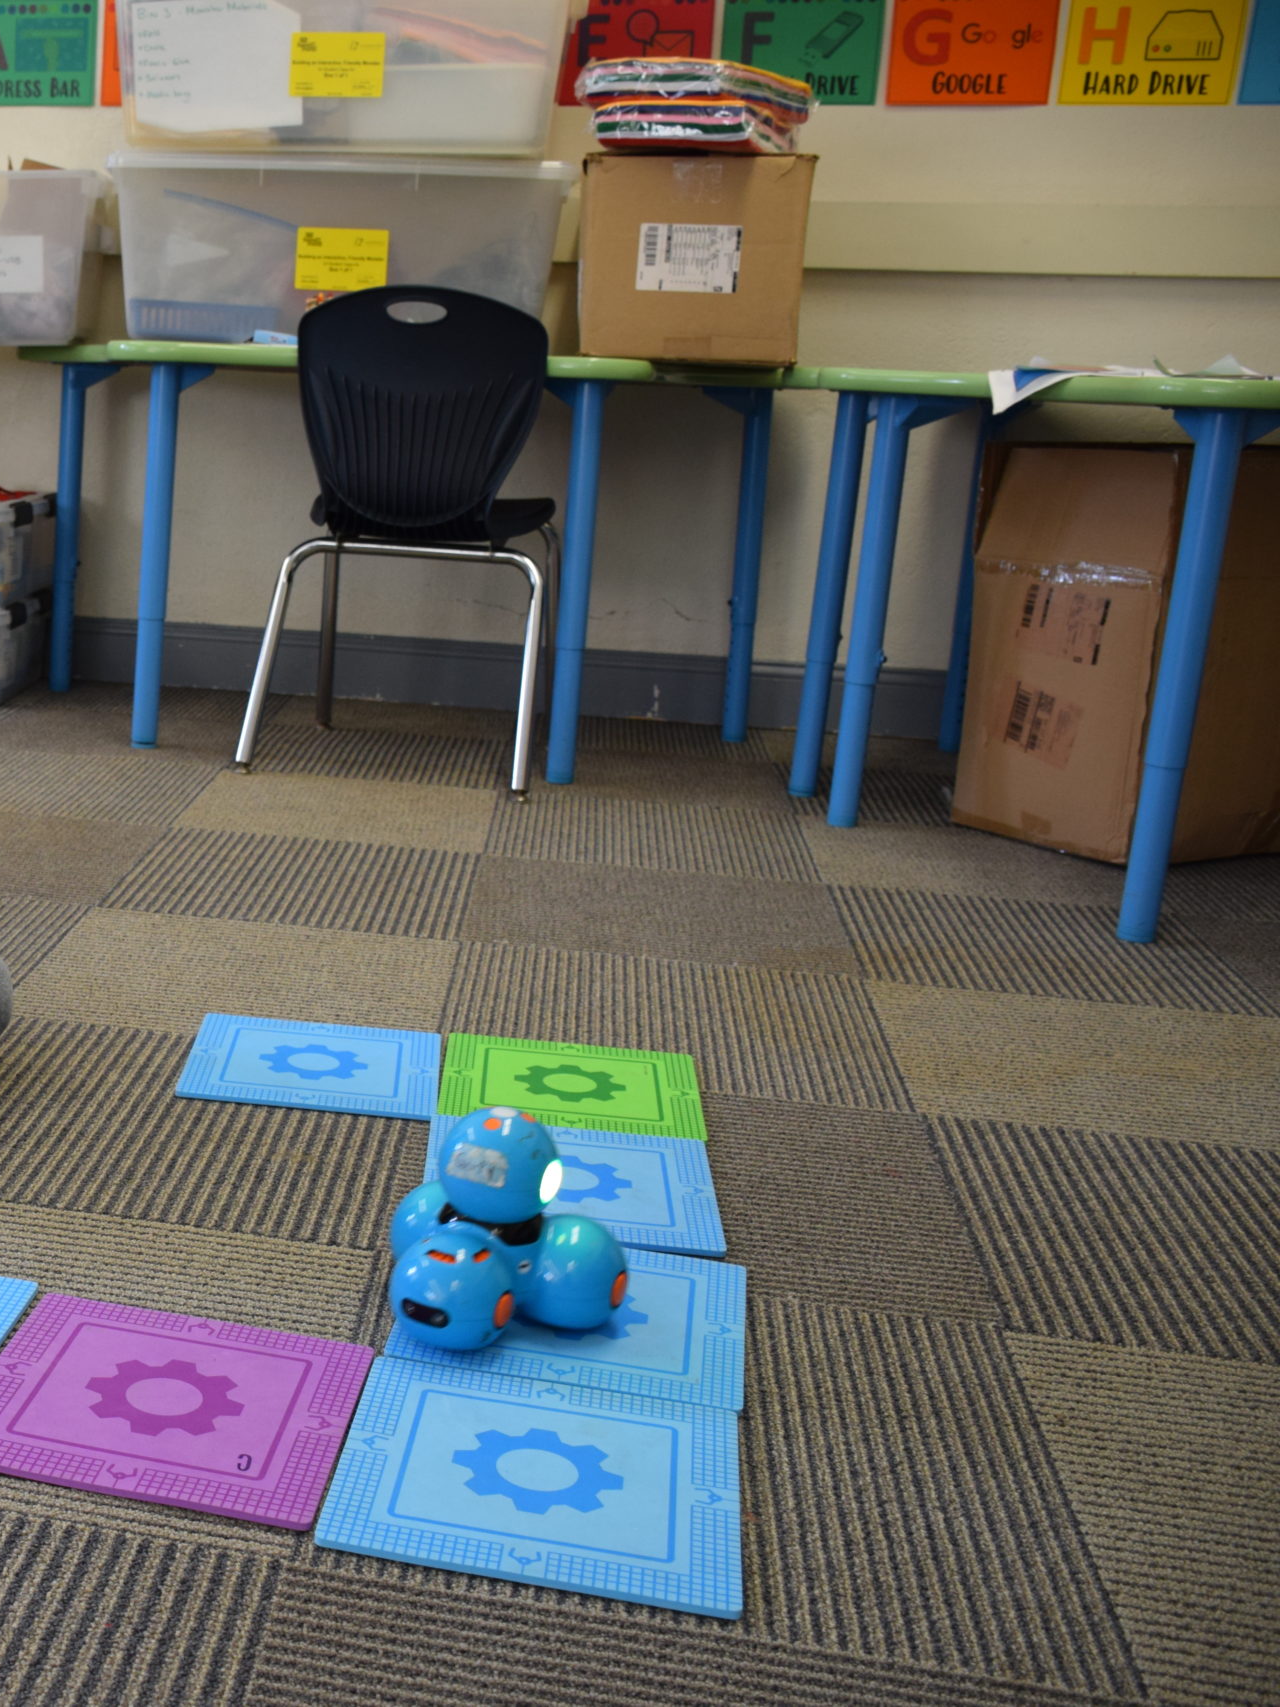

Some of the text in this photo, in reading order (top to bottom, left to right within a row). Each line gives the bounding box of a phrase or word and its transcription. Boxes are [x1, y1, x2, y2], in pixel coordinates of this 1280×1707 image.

[903, 8, 953, 66] G
[1077, 6, 1132, 65] H
[50, 77, 80, 98] BAR
[931, 71, 1008, 95] GOOGLE
[1083, 70, 1211, 96] HARD DRIVE
